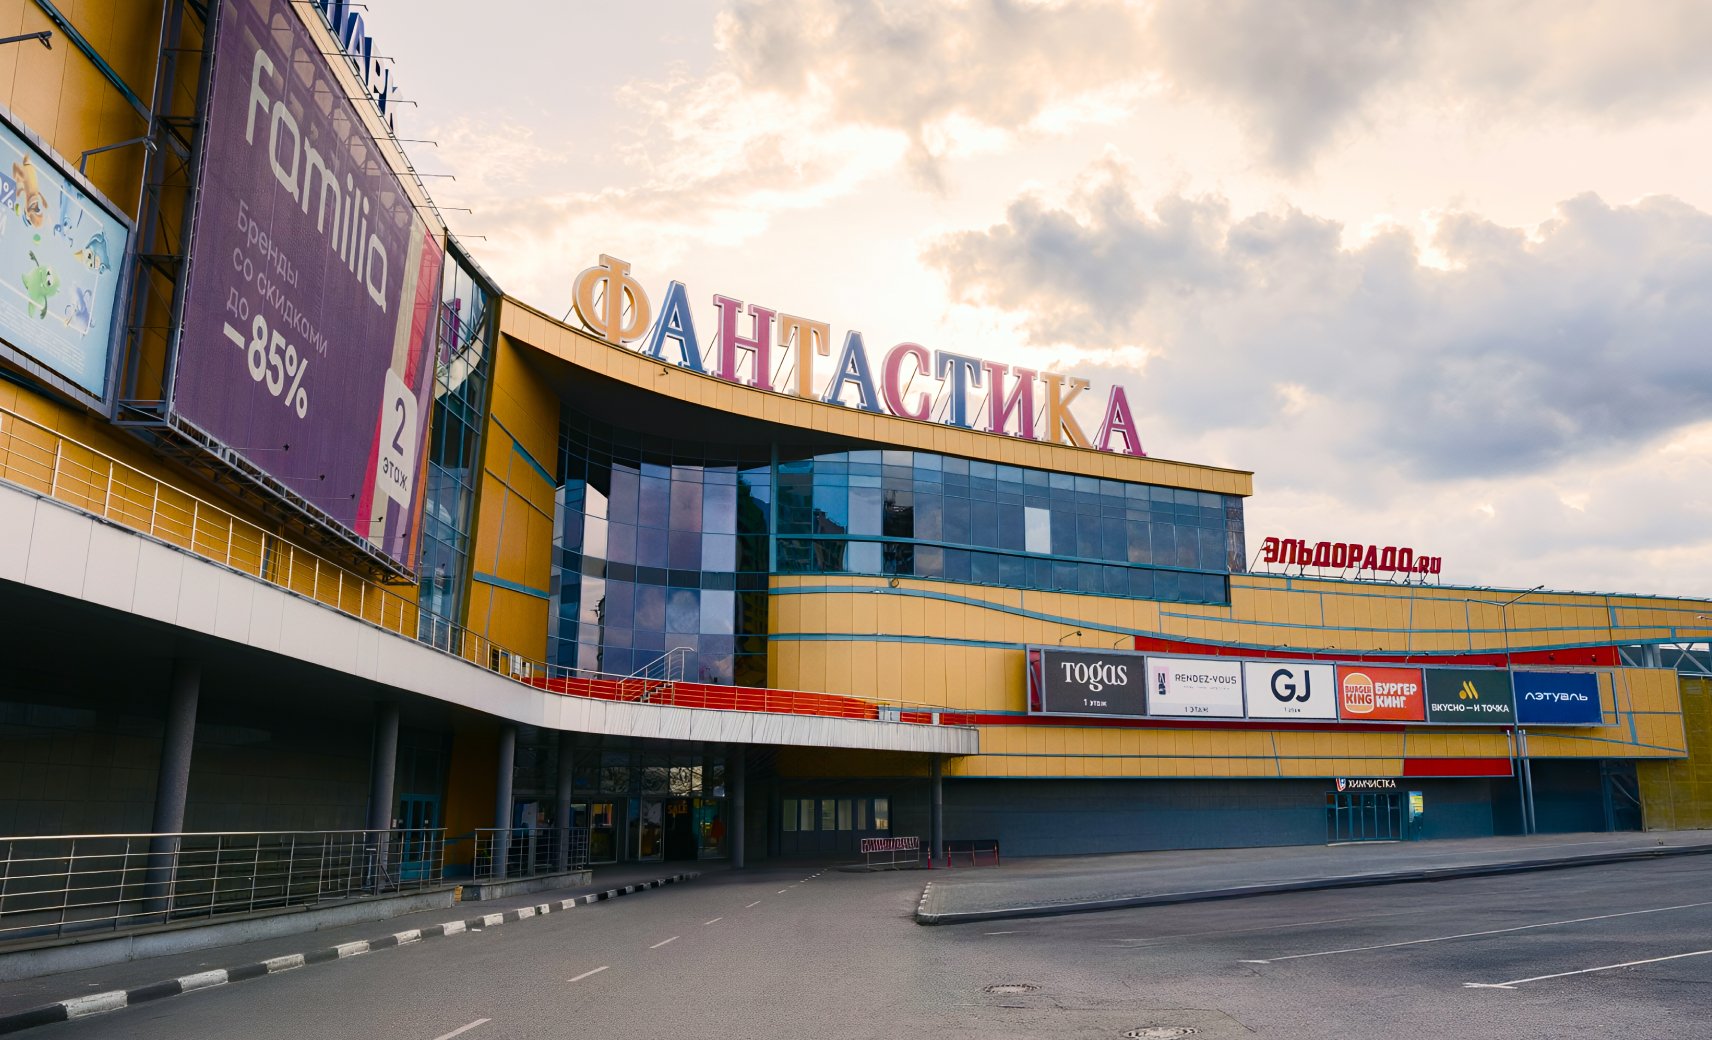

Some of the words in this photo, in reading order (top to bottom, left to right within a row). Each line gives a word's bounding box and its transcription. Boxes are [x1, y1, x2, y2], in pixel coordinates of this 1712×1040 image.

[237, 199, 299, 289] Бренды
[227, 286, 249, 321] до
[233, 247, 253, 282] со
[257, 272, 328, 358] скидками
[572, 253, 1148, 457] ФАНТАСТИКА
[392, 397, 406, 457] 2
[382, 457, 408, 492] этаж
[1260, 536, 1442, 574] ЭЛЬДОРАДО.RU
[1175, 673, 1237, 685] RENDEZ-VOUS
[1271, 668, 1311, 703] GJ
[1345, 685, 1372, 694] BURGER
[1374, 682, 1417, 696] БУРГЕР
[1083, 698, 1088, 707] 1
[1345, 694, 1372, 705] KING
[1376, 696, 1407, 709] КИНГ
[1431, 703, 1466, 712] ВКУСНО
[1481, 704, 1510, 713] ТОЧКА
[1348, 779, 1396, 789] ХИМЧИСТКА
[667, 803, 688, 814] SALE
